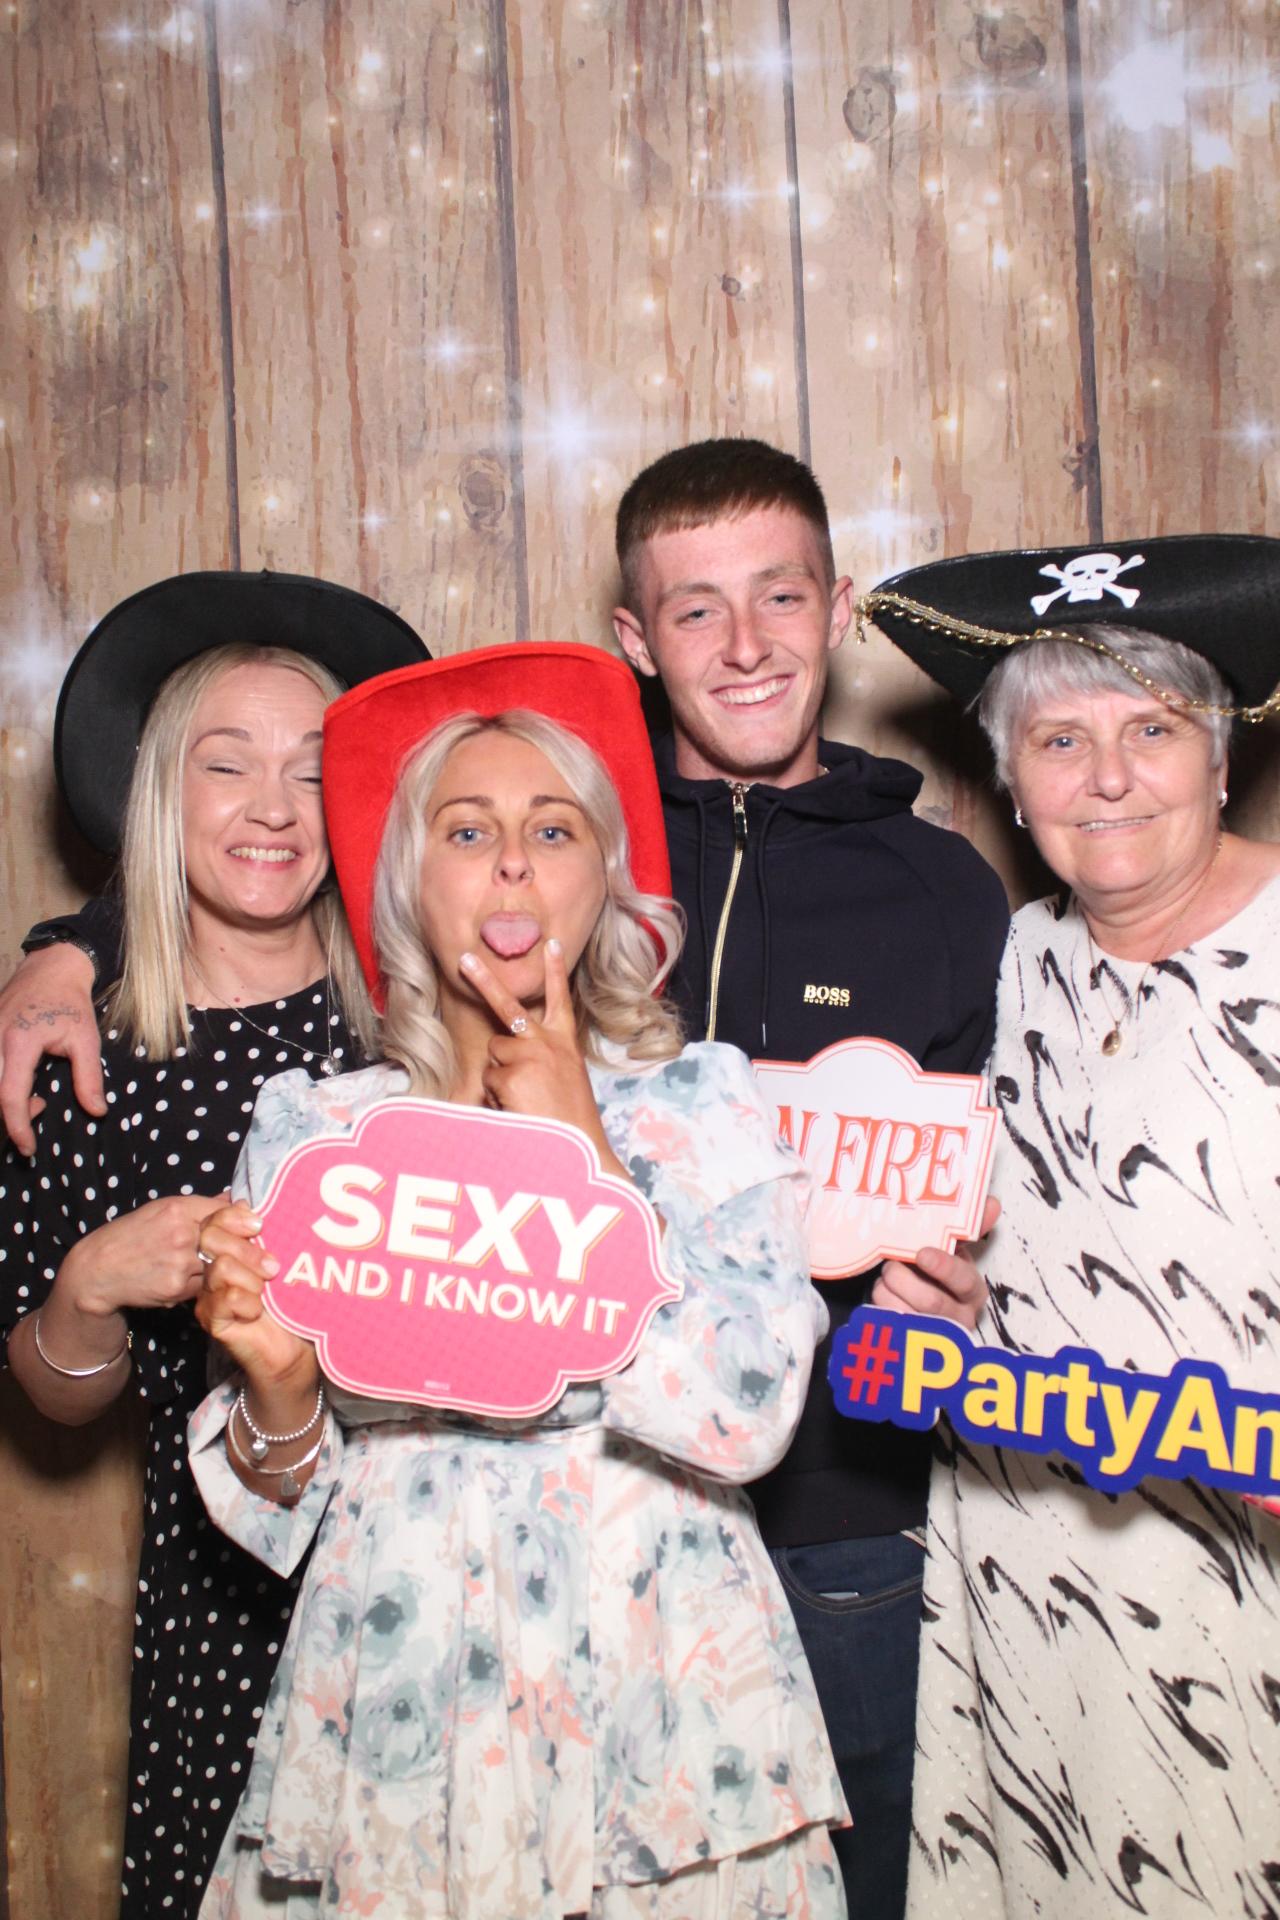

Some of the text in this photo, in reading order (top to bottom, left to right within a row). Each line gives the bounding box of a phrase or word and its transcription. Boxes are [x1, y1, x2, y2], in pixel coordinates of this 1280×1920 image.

[803, 984, 850, 1003] BOSS
[822, 1112, 970, 1209] FIRE
[311, 1164, 624, 1284] SEXY
[283, 1252, 627, 1336] AND I KNOW IT
